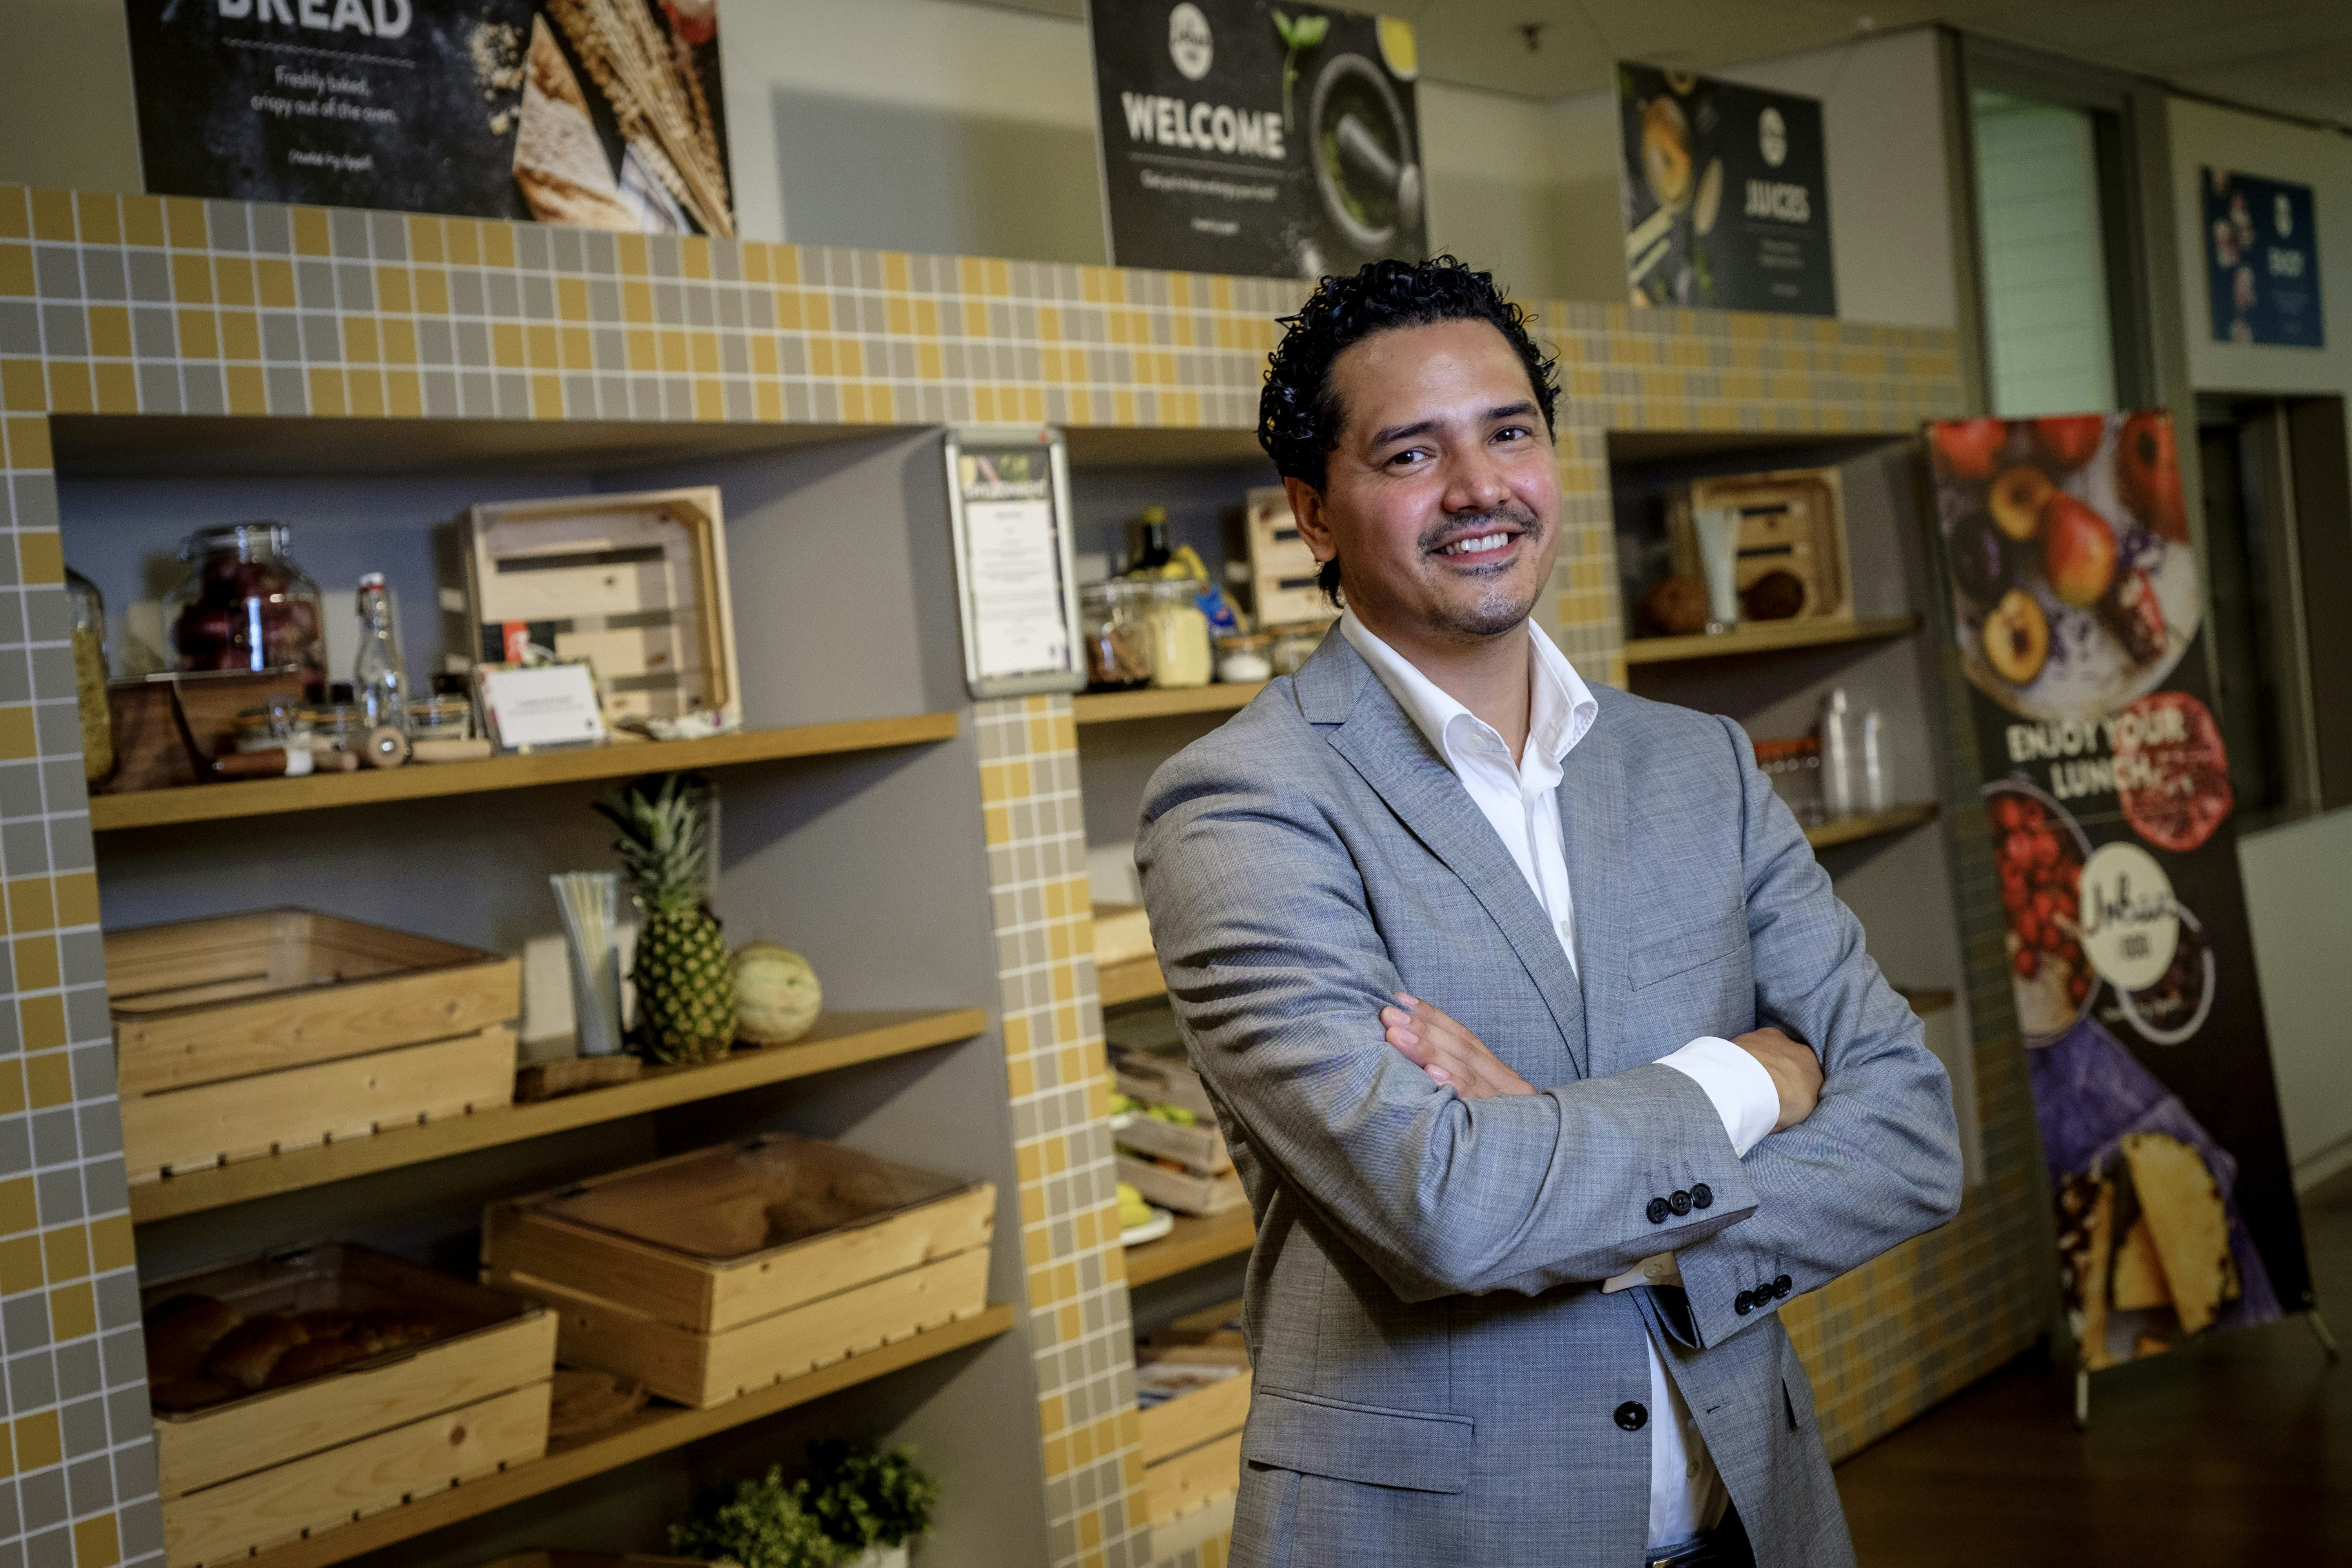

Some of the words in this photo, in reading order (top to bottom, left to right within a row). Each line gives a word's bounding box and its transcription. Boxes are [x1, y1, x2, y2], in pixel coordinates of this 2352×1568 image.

[275, 64, 325, 97] Freshly
[251, 94, 293, 118] crispy
[294, 99, 319, 116] out
[320, 96, 337, 117] of
[338, 99, 362, 120] the
[1121, 91, 1286, 159] WELCOME
[2005, 720, 2099, 762] ENJOY
[2105, 707, 2187, 748] YOUR
[2051, 754, 2150, 799] LUNCH
